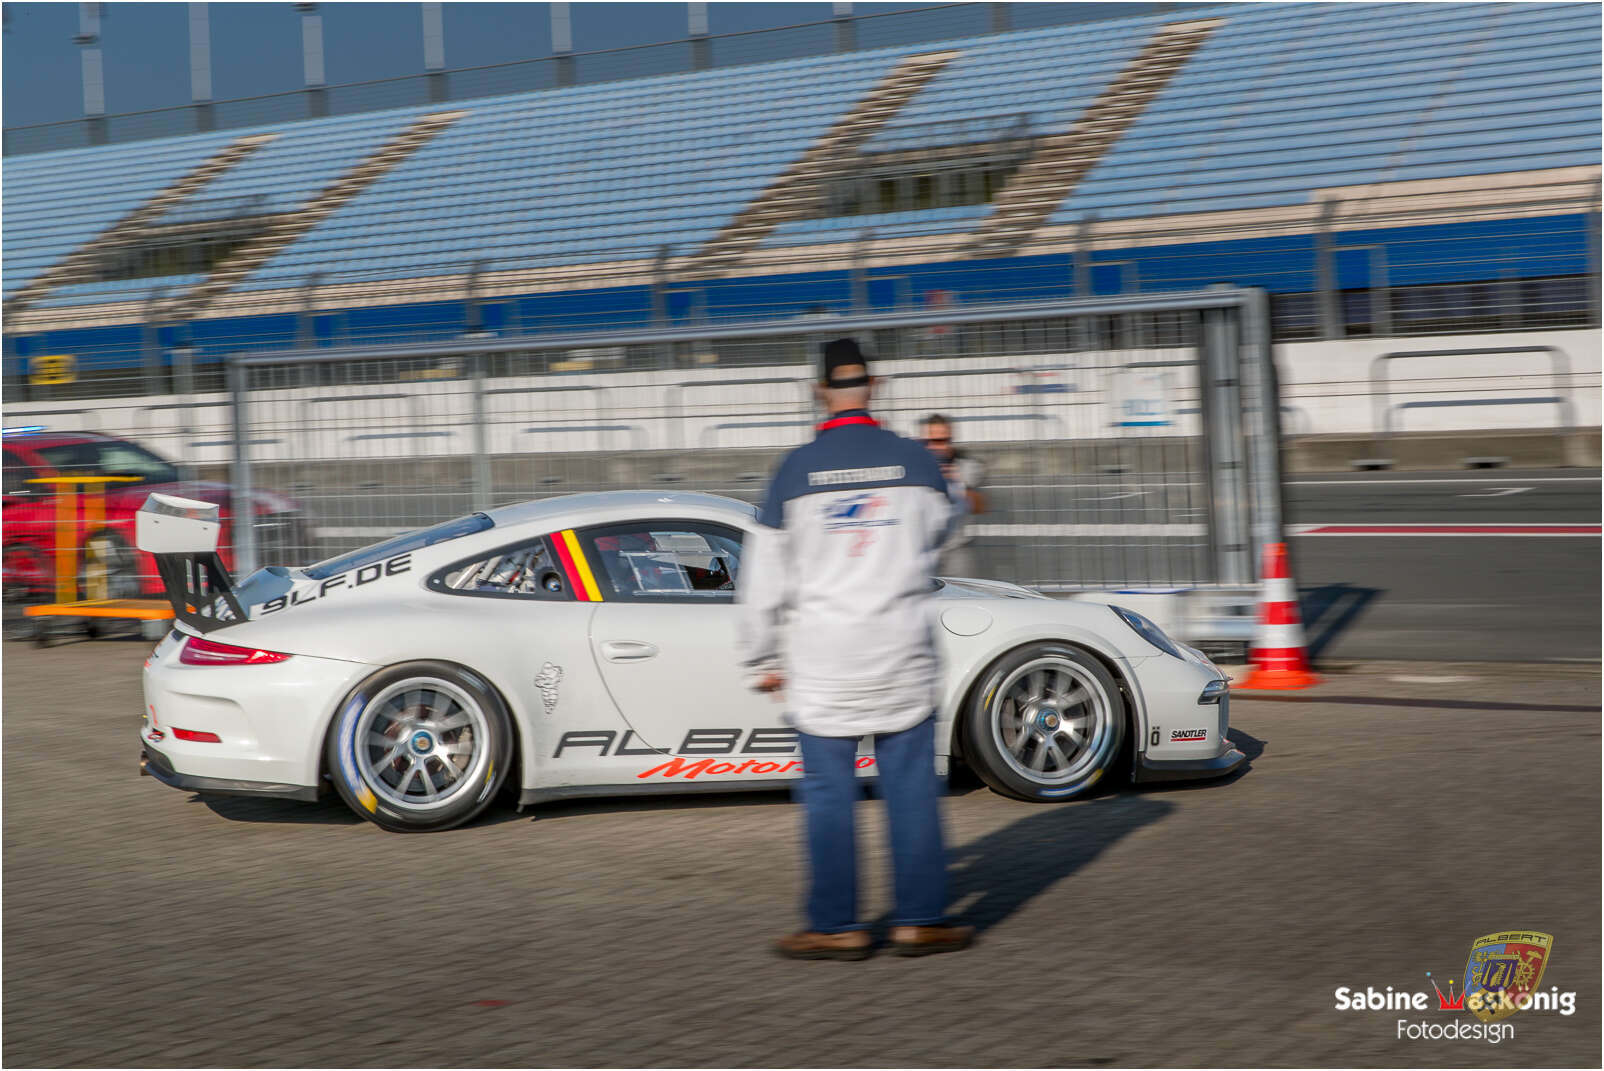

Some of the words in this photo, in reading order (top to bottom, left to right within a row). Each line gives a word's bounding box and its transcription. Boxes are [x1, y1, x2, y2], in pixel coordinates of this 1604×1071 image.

[260, 553, 412, 616] 9LF.DE
[552, 727, 801, 758] ALBE
[1171, 729, 1207, 738] SANDTLER
